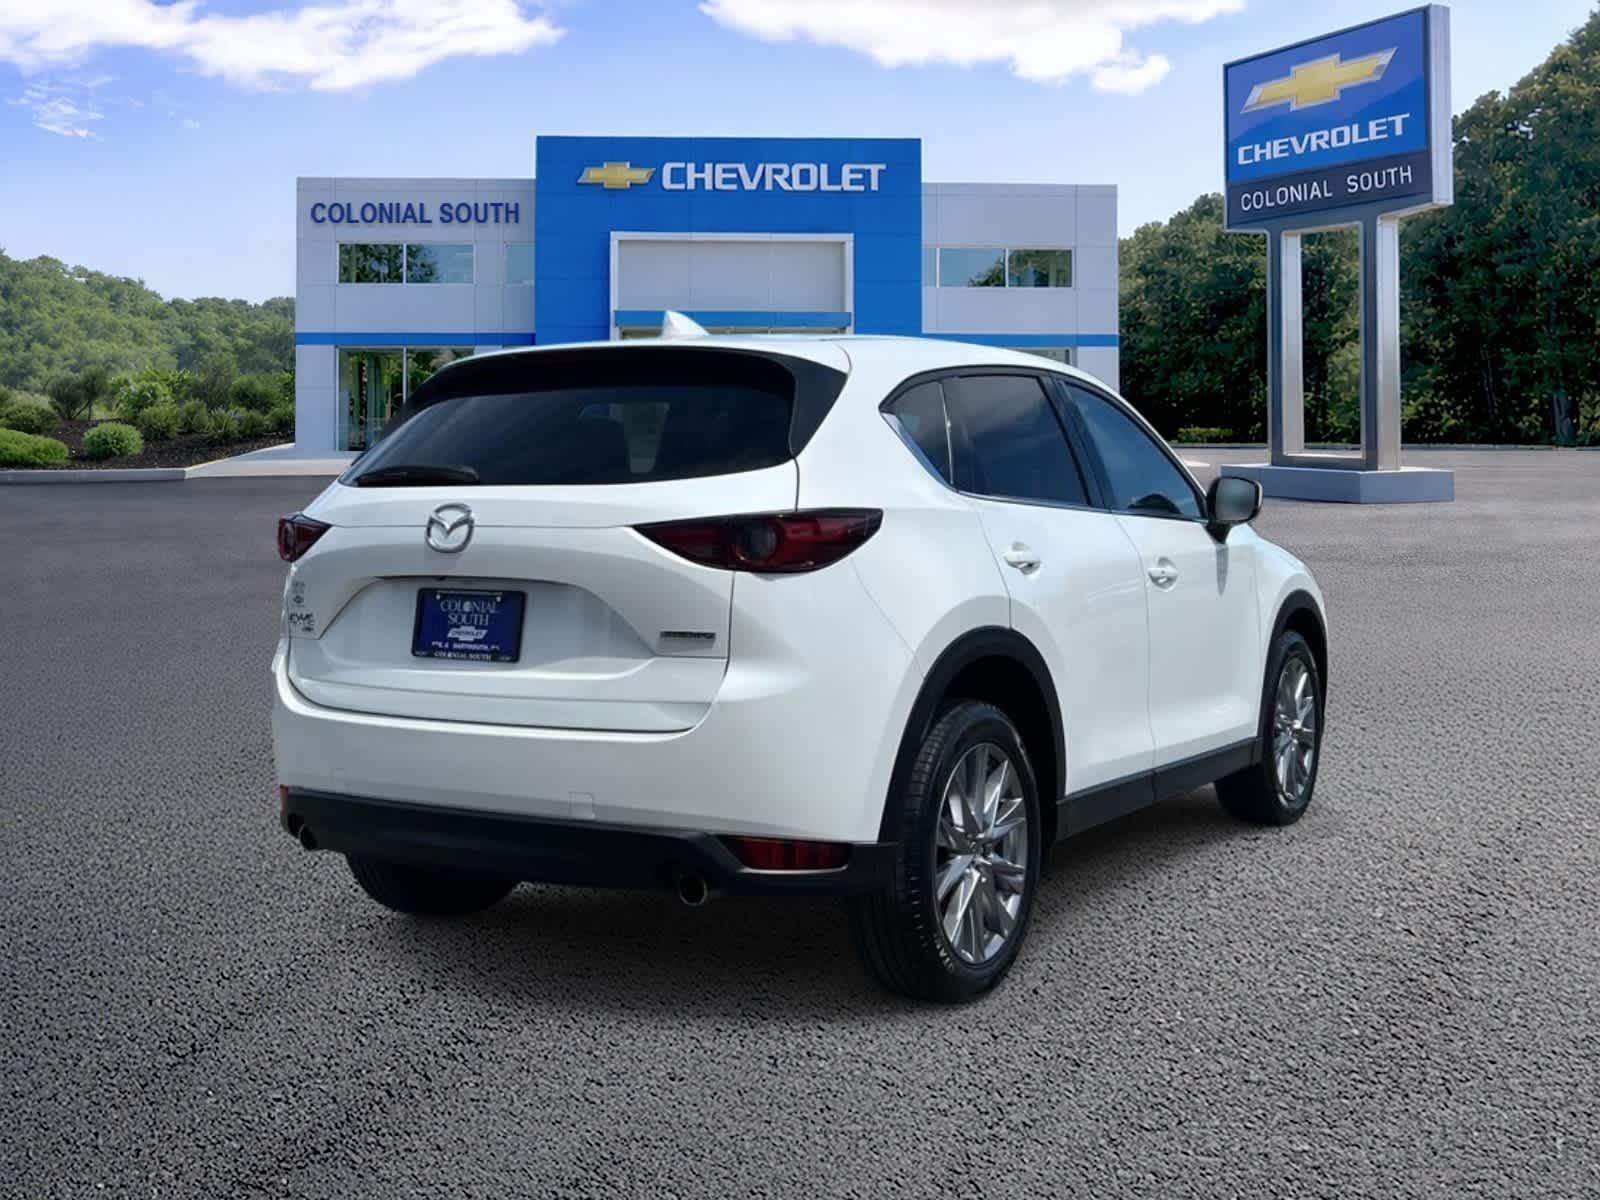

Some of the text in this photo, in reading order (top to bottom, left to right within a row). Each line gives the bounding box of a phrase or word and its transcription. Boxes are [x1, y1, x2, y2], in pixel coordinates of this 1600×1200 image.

[1238, 113, 1410, 165] CHEVROLET
[662, 162, 887, 191] CHEVROLET
[1241, 165, 1412, 211] COLONIAL SOUTH
[310, 202, 520, 224] COLONIAL SOUTH
[448, 613, 489, 626] SOUTH
